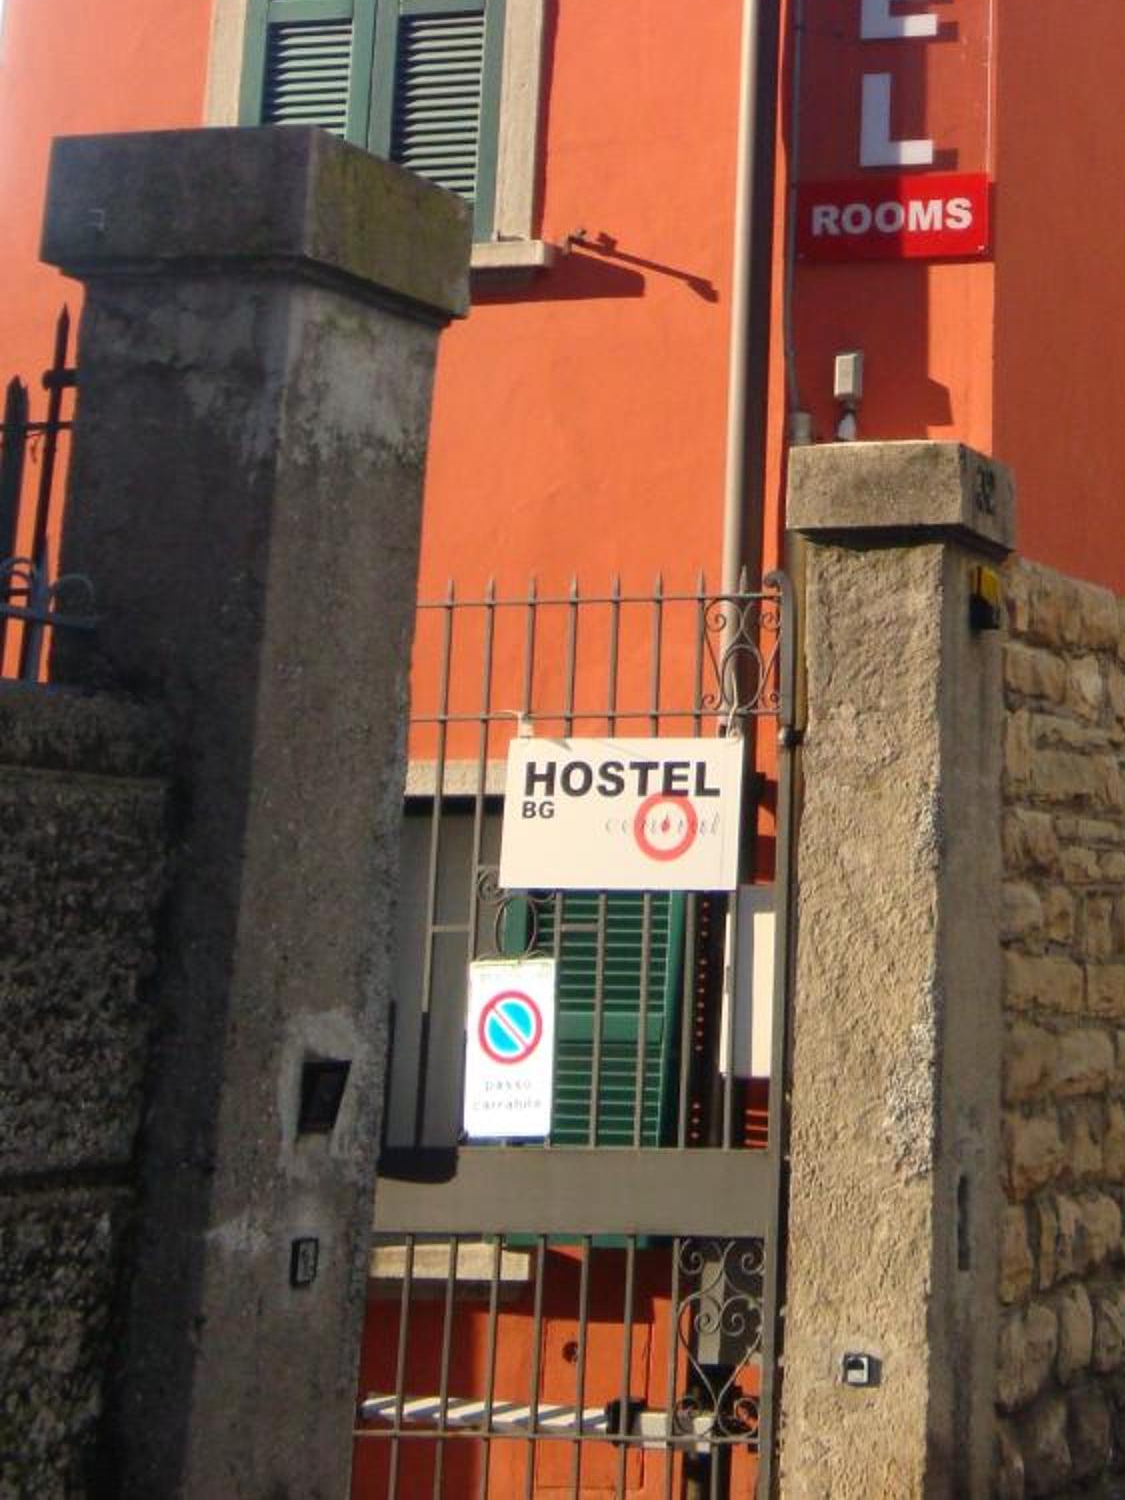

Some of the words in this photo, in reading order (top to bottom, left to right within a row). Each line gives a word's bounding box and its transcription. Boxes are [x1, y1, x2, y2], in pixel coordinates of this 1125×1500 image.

[811, 197, 973, 237] ROOMS
[523, 760, 721, 798] HOSTEL
[521, 800, 556, 820] BG
